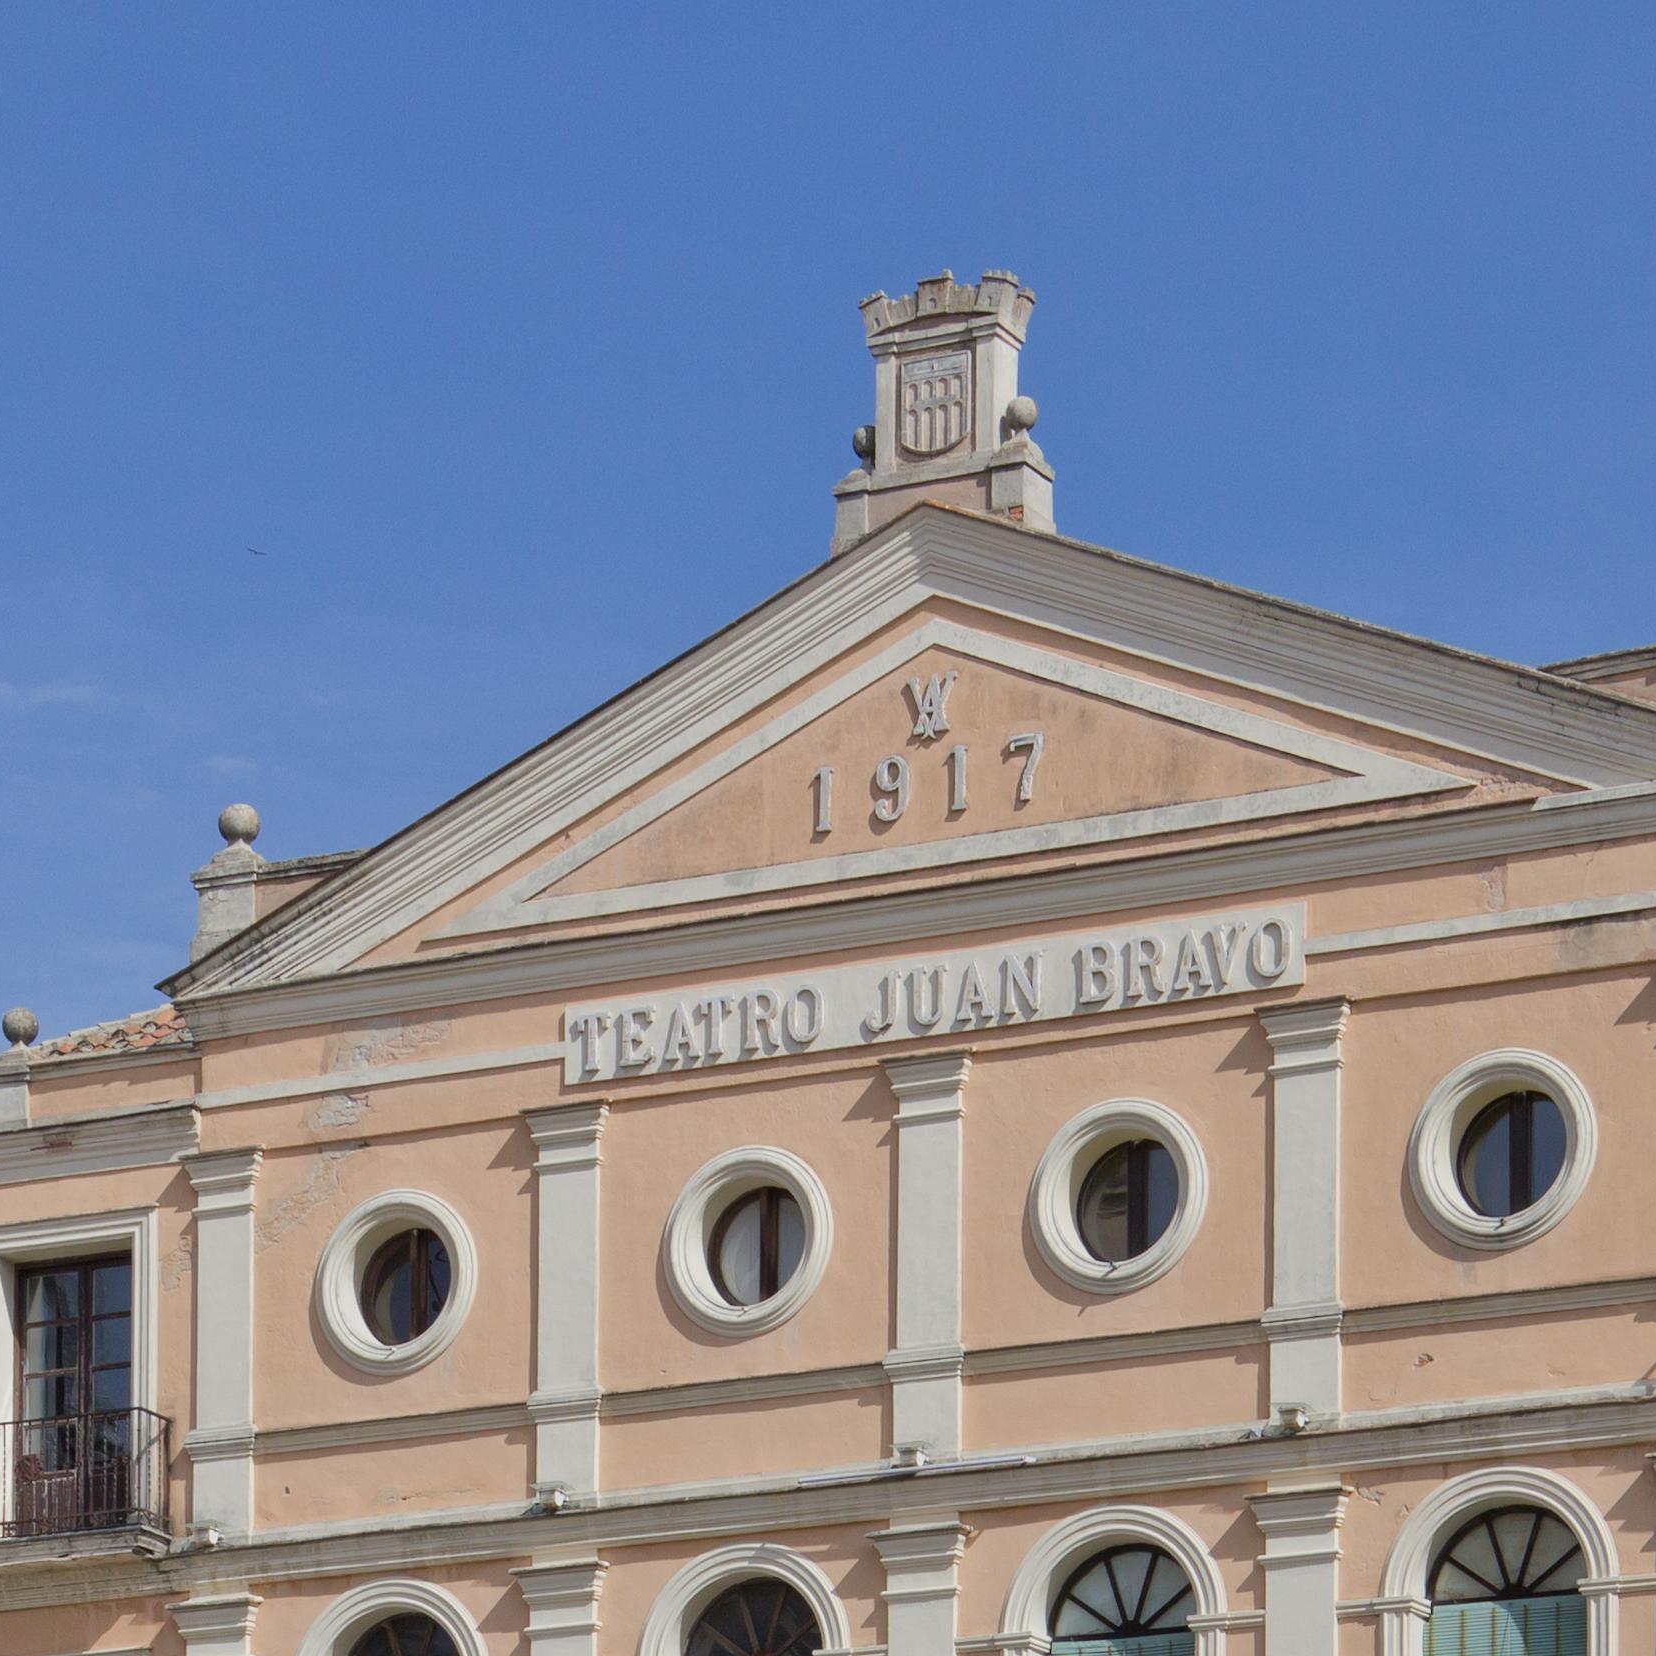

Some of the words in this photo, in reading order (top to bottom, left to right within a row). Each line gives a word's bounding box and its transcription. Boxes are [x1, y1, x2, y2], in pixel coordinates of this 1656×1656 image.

[815, 732, 1044, 833] 1917
[572, 984, 825, 1073] TEATRO
[863, 949, 1045, 1034] JUAN
[1077, 916, 1294, 1004] BRAVO
